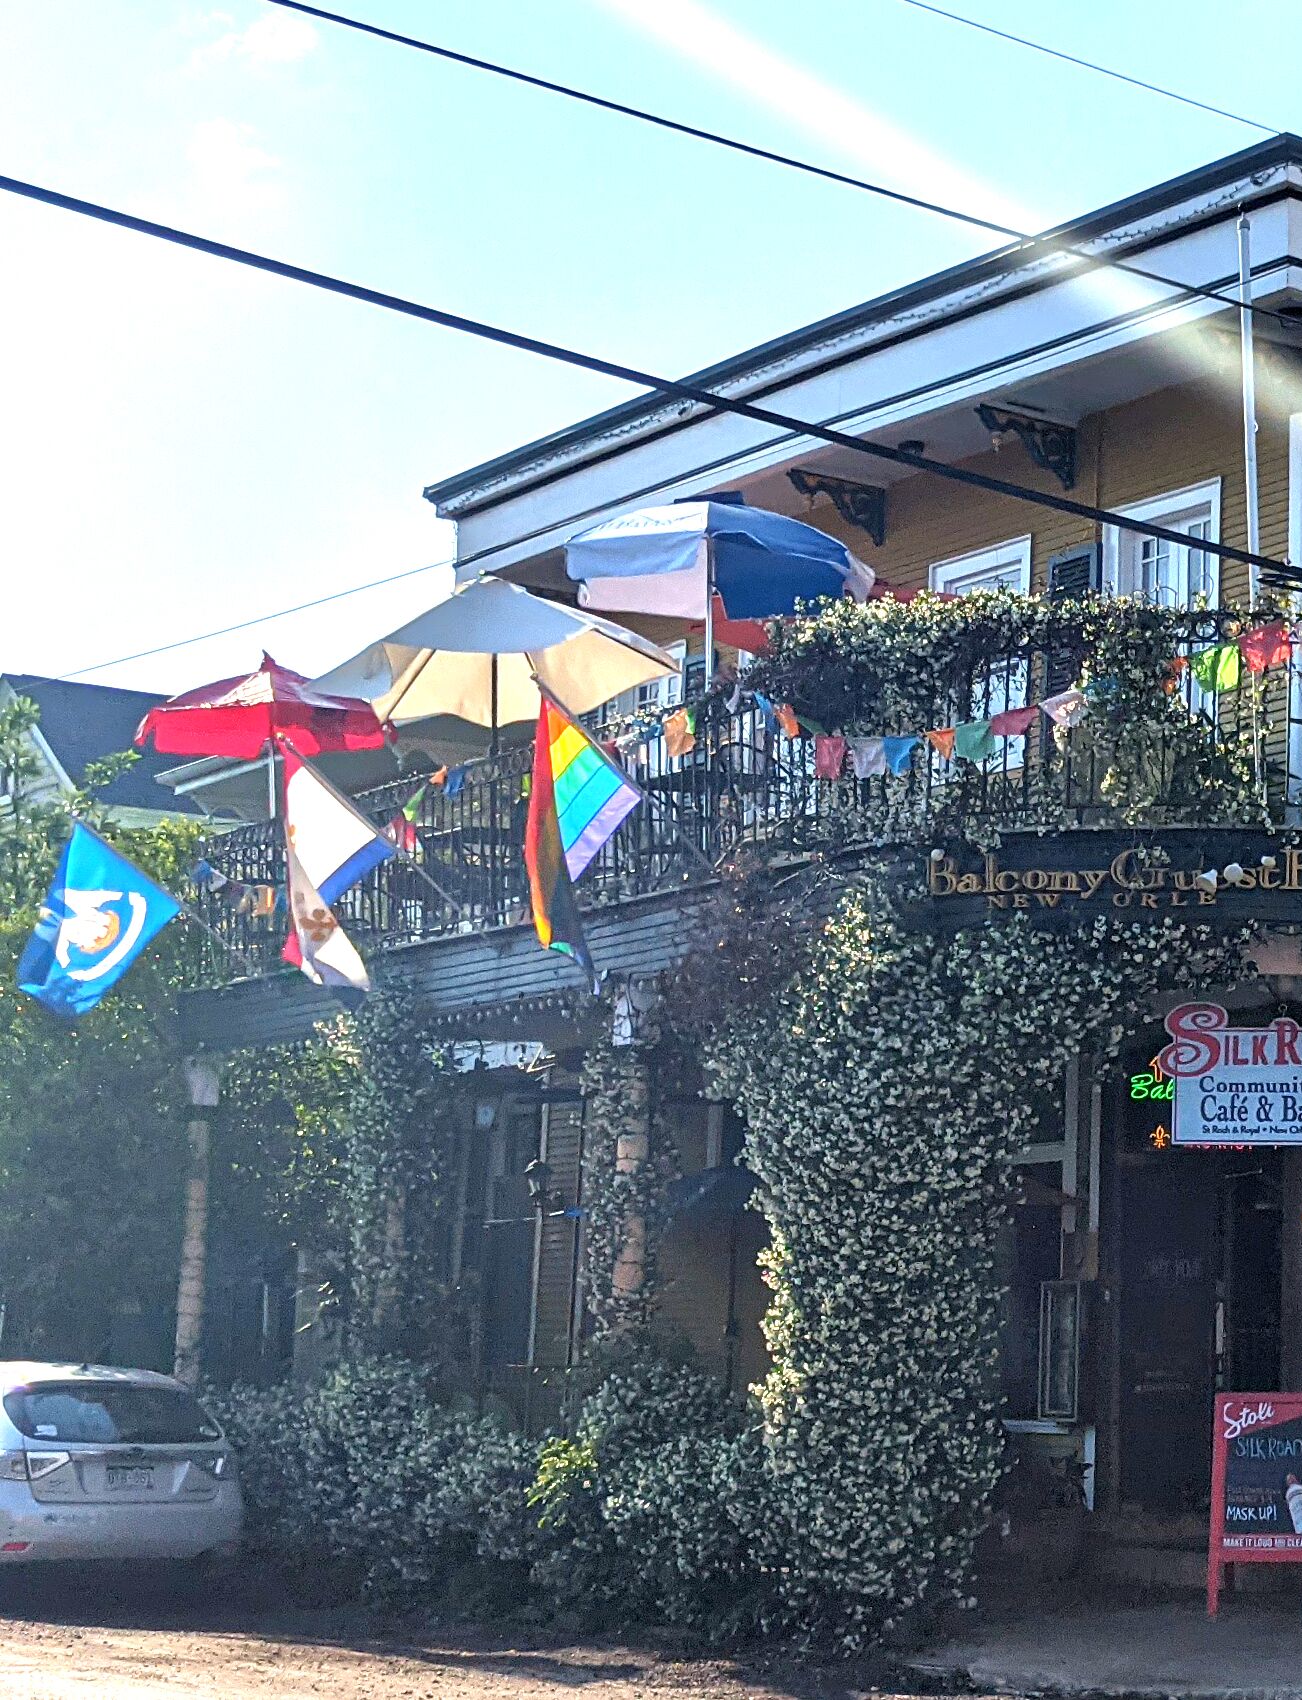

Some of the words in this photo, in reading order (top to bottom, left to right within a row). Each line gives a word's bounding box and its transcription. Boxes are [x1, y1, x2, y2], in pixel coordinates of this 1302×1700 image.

[927, 851, 1109, 899] Balcony
[987, 893, 1060, 909] NEW
[1160, 1003, 1269, 1076] SILK
[1201, 1094, 1248, 1122] Café
[1256, 1096, 1273, 1122] &
[1223, 1402, 1275, 1439] Stoli
[1236, 1437, 1265, 1457] SILK
[1226, 1505, 1257, 1521] MASK
[1259, 1504, 1277, 1521] UP!
[1223, 1538, 1243, 1547] MAKE
[1246, 1538, 1252, 1547] IT
